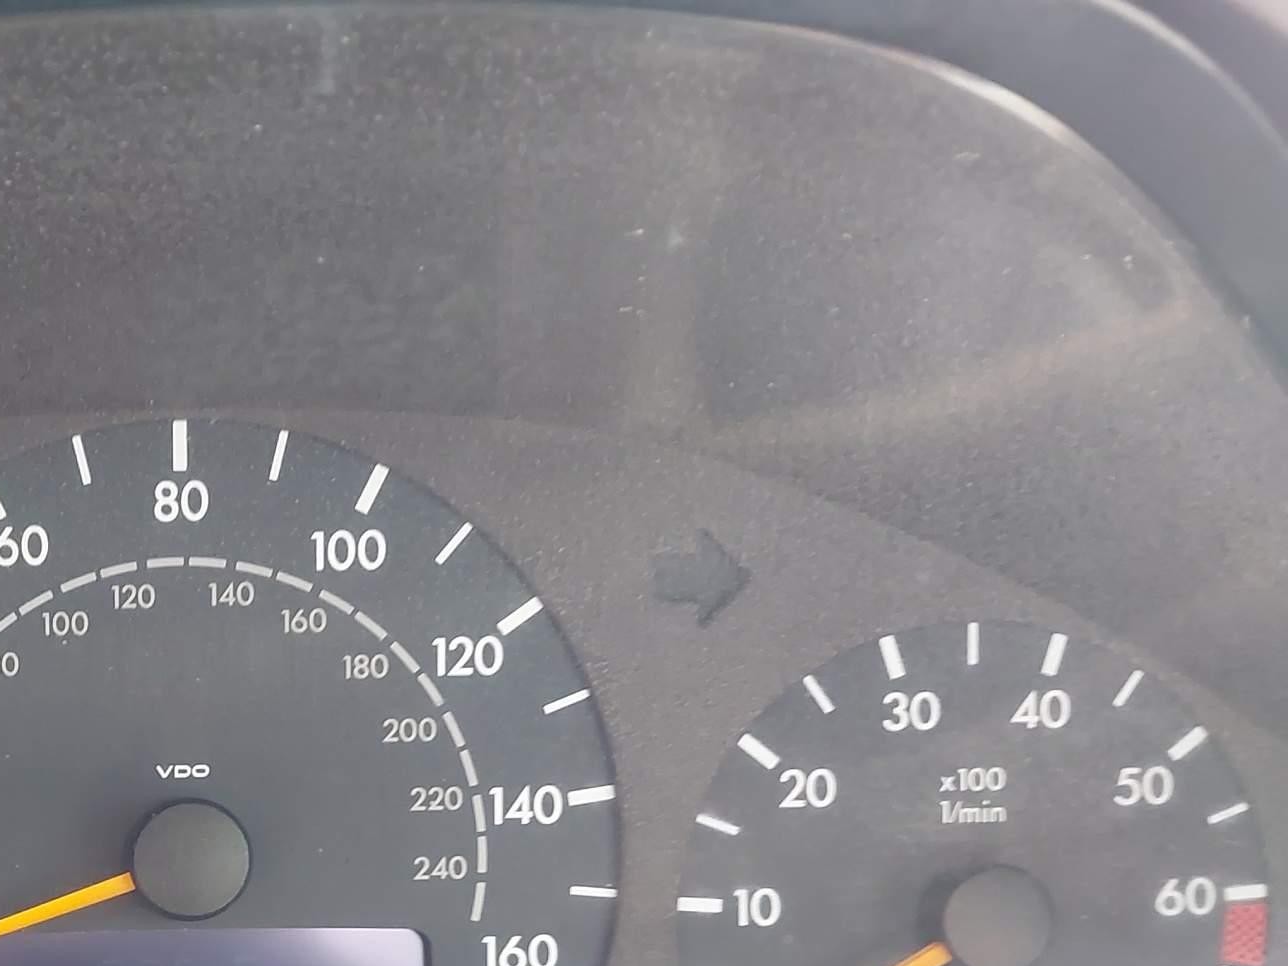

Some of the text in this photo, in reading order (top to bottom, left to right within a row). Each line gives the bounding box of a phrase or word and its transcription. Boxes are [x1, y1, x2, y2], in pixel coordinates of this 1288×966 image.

[154, 480, 208, 522] 80
[311, 530, 386, 571] 100
[112, 584, 155, 609] 120
[209, 582, 254, 606] 140
[43, 612, 88, 635] 100
[282, 608, 326, 632] 160
[344, 654, 388, 679] 180
[433, 637, 503, 678] 120
[883, 692, 940, 731] 30
[1011, 690, 1070, 728] 40
[383, 718, 436, 742] 200
[157, 765, 209, 778] VDO
[940, 768, 1005, 791] x100
[1114, 766, 1172, 805] 50
[411, 787, 462, 811] 220
[779, 769, 836, 807] 20
[489, 785, 562, 825] 140
[414, 856, 467, 880] 240
[734, 888, 780, 926] 10
[1156, 878, 1215, 915] 60
